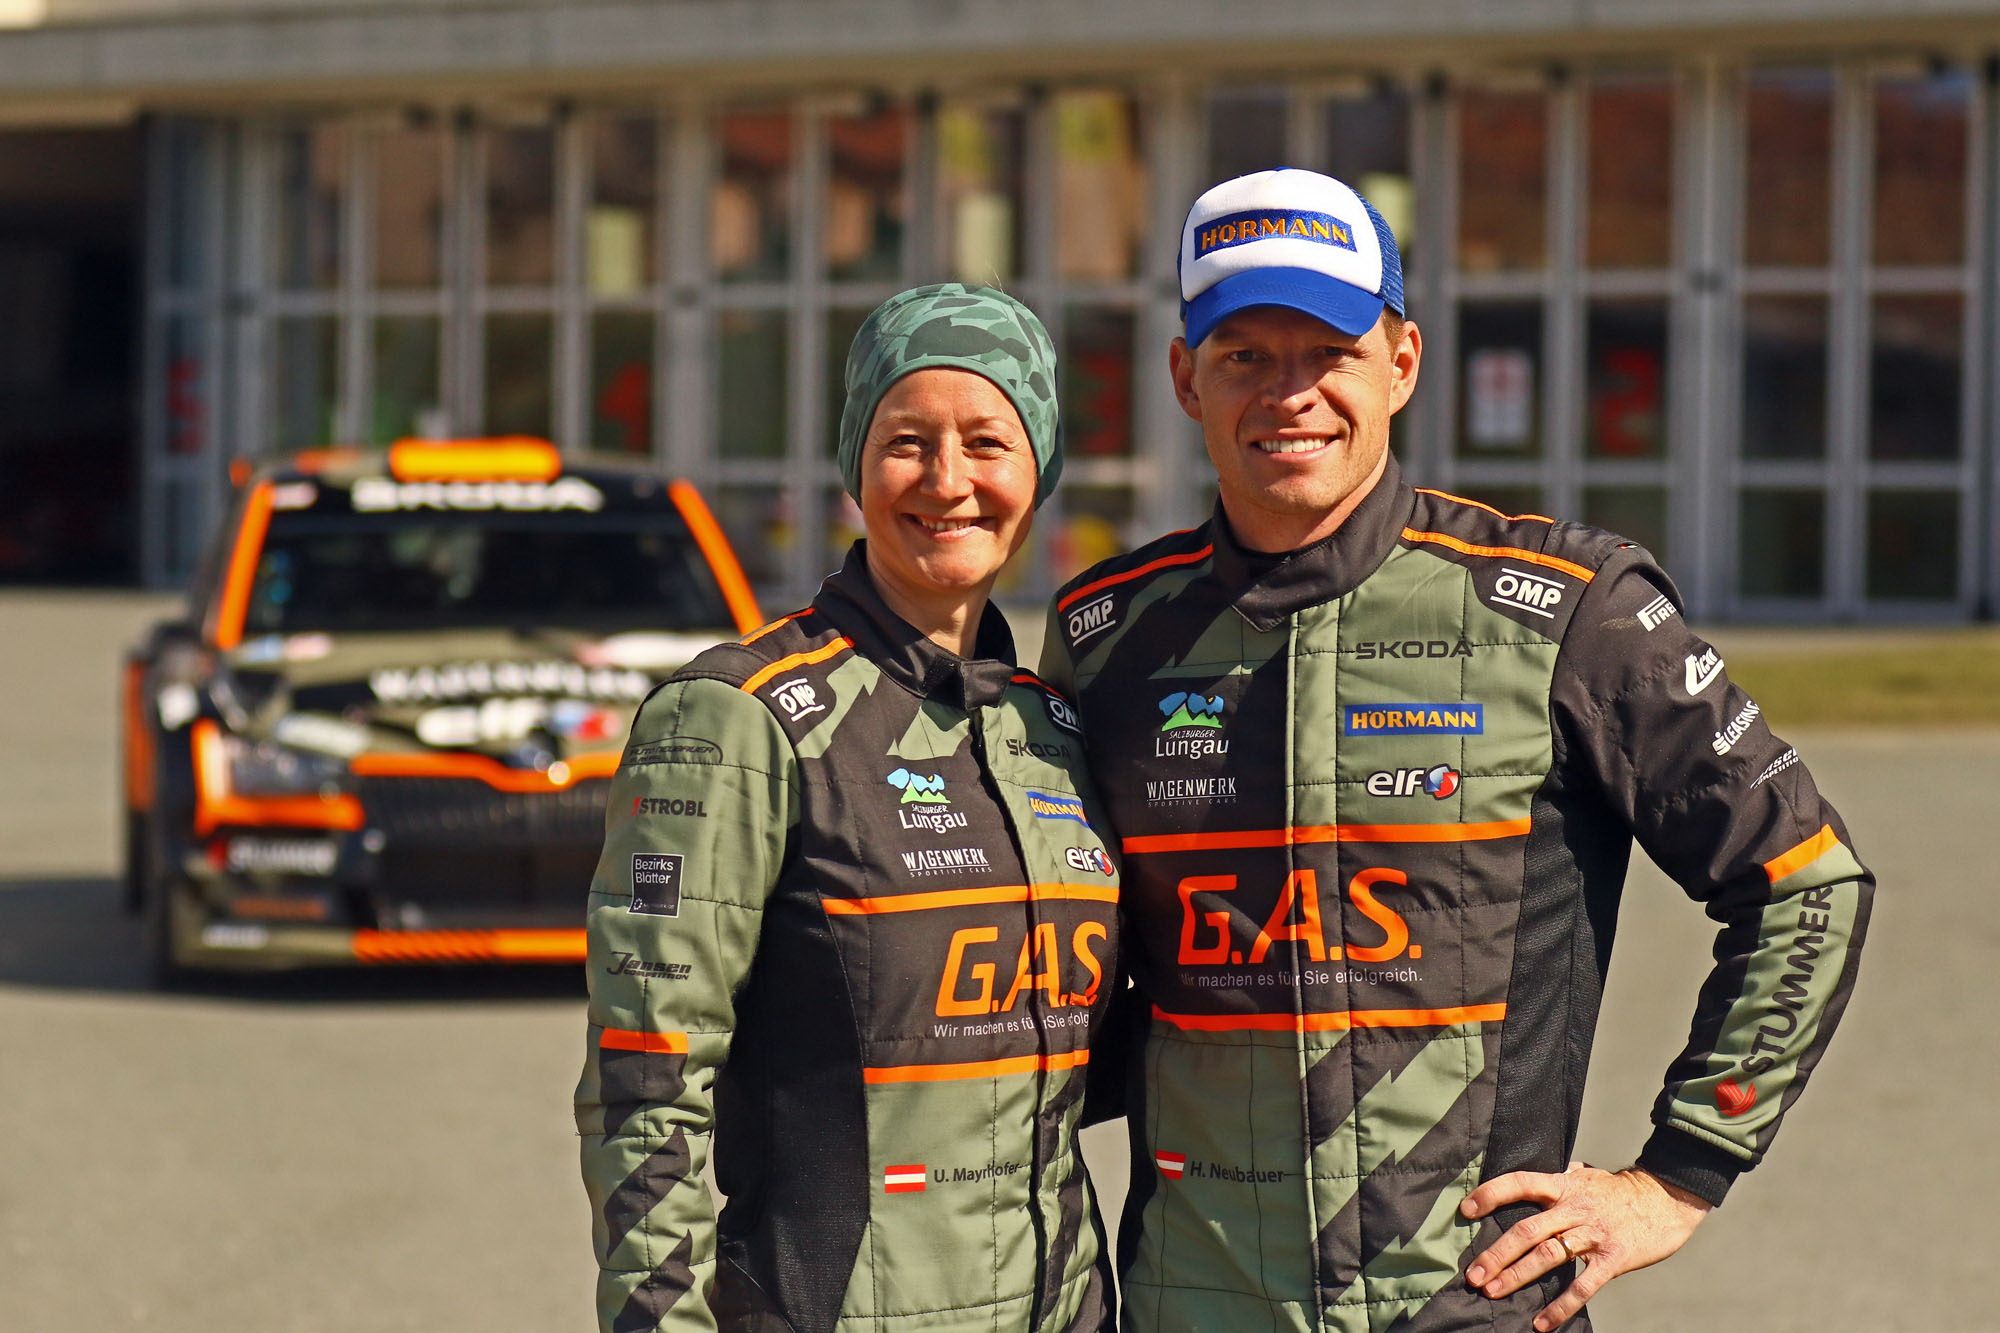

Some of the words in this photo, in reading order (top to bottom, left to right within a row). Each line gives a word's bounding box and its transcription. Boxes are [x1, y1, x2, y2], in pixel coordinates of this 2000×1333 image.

[1200, 217, 1350, 251] HÖRMANN
[1495, 575, 1562, 609] OMP
[1070, 599, 1114, 638] OMP
[1049, 700, 1080, 727] OM
[1351, 709, 1477, 730] HÖRMANN
[1169, 729, 1216, 739] SALZBURGER
[1156, 737, 1229, 760] Lungau
[1146, 777, 1237, 799] WAGENWERK
[1366, 768, 1427, 797] elf
[898, 809, 968, 834] Lungau
[635, 858, 674, 871] Bezirks
[901, 848, 988, 869] WAGENWERK
[1066, 846, 1096, 872] elf
[910, 868, 963, 878] SPORTIVE
[1177, 867, 1423, 966] G.A.S.
[606, 951, 692, 975] Jansen
[1199, 973, 1252, 987] machen
[1257, 974, 1274, 986] es
[1278, 971, 1300, 986] für
[1304, 970, 1329, 985] Sie
[1335, 967, 1423, 986] erfolgreich.
[1741, 883, 1833, 1075] STUMMER
[934, 1023, 958, 1038] Wir
[963, 1020, 1005, 1037] machen
[1007, 1022, 1020, 1032] es
[1047, 1015, 1065, 1029] Sie
[934, 1168, 950, 1184] U.
[953, 1161, 1020, 1184] Mayrhofer
[1189, 1161, 1207, 1178] H.
[1210, 1163, 1284, 1184] Neubauer
